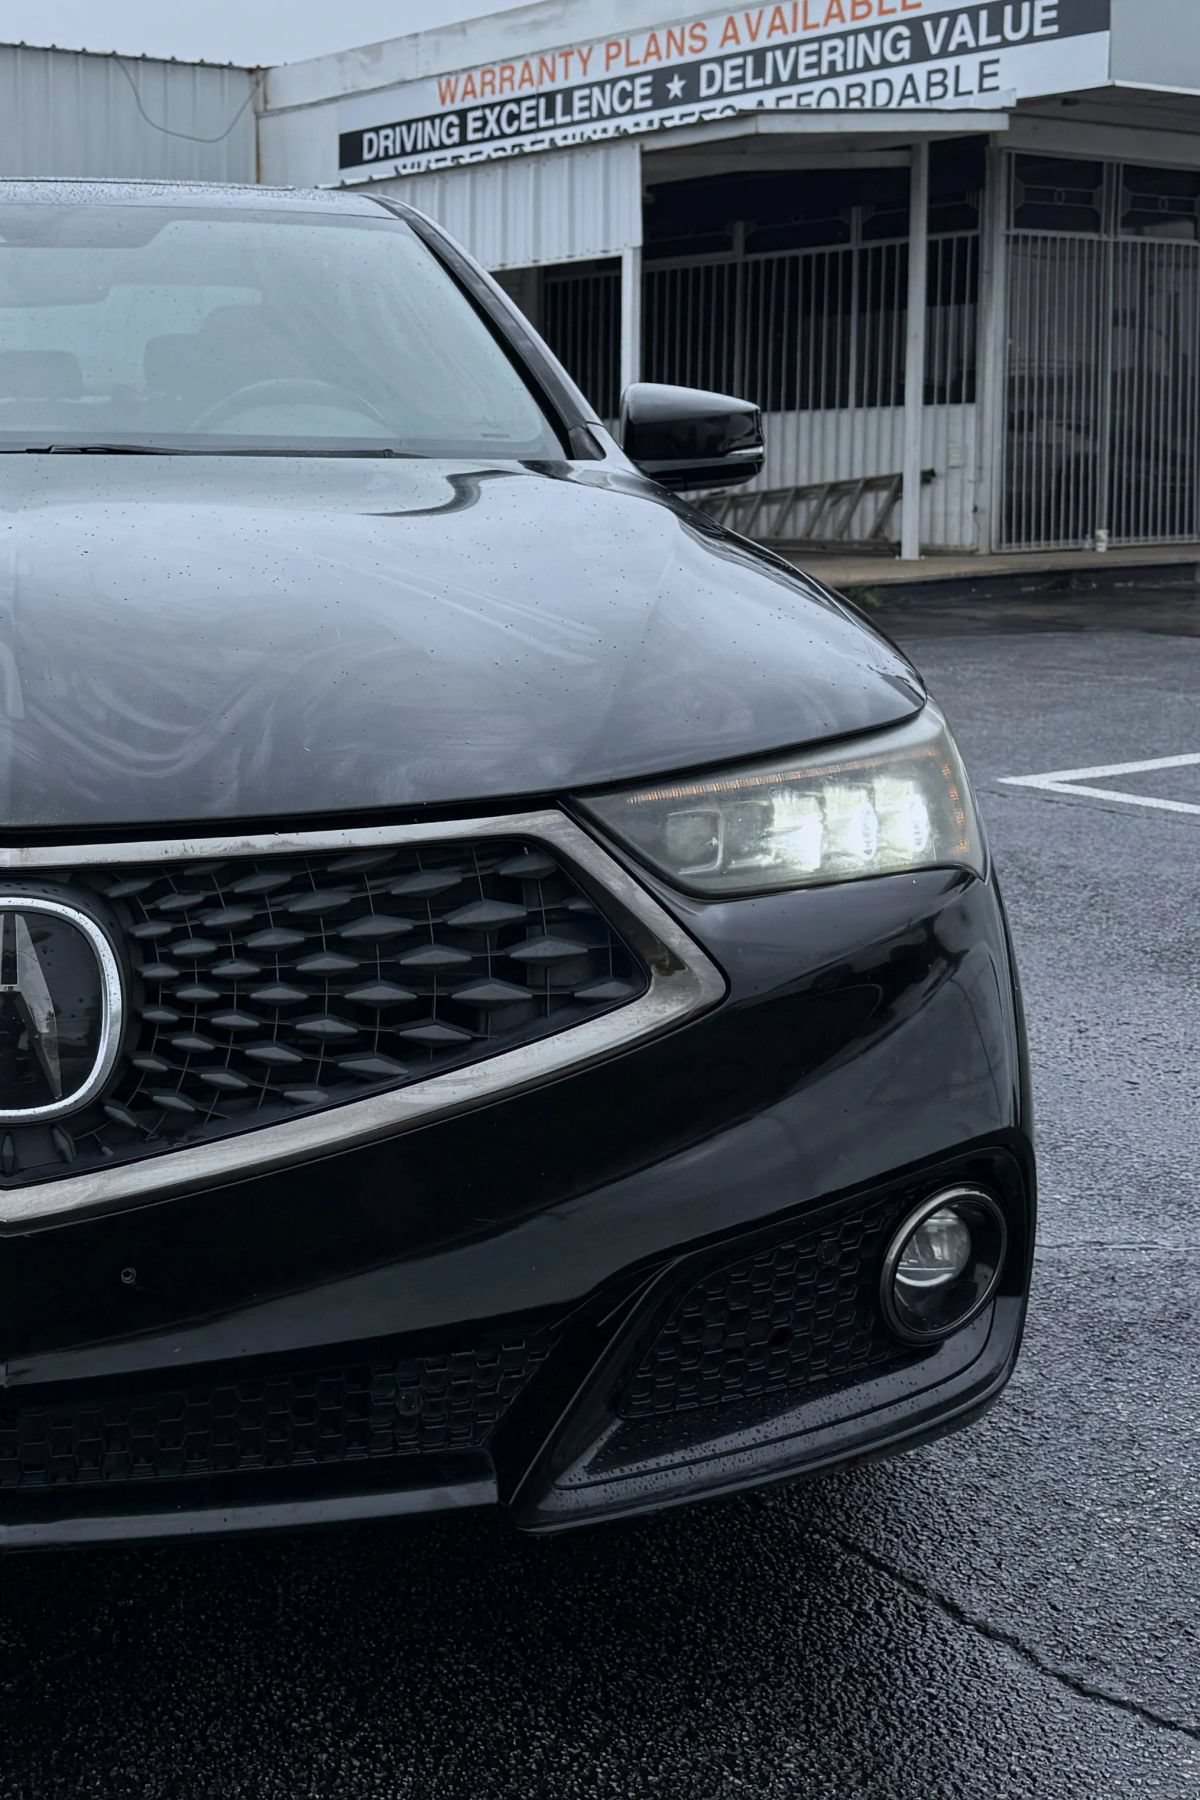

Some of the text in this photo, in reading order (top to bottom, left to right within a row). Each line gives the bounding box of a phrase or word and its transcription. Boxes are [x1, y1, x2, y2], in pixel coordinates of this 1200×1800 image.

[362, 114, 460, 161] DRIVING
[466, 75, 653, 141] EXCELLENCE
[699, 25, 911, 98] DELIVERING
[922, 0, 1059, 55] VALUE
[437, 47, 593, 106] WARRANTY
[605, 22, 708, 72] PLANS
[756, 58, 1000, 108] ORDABLE
